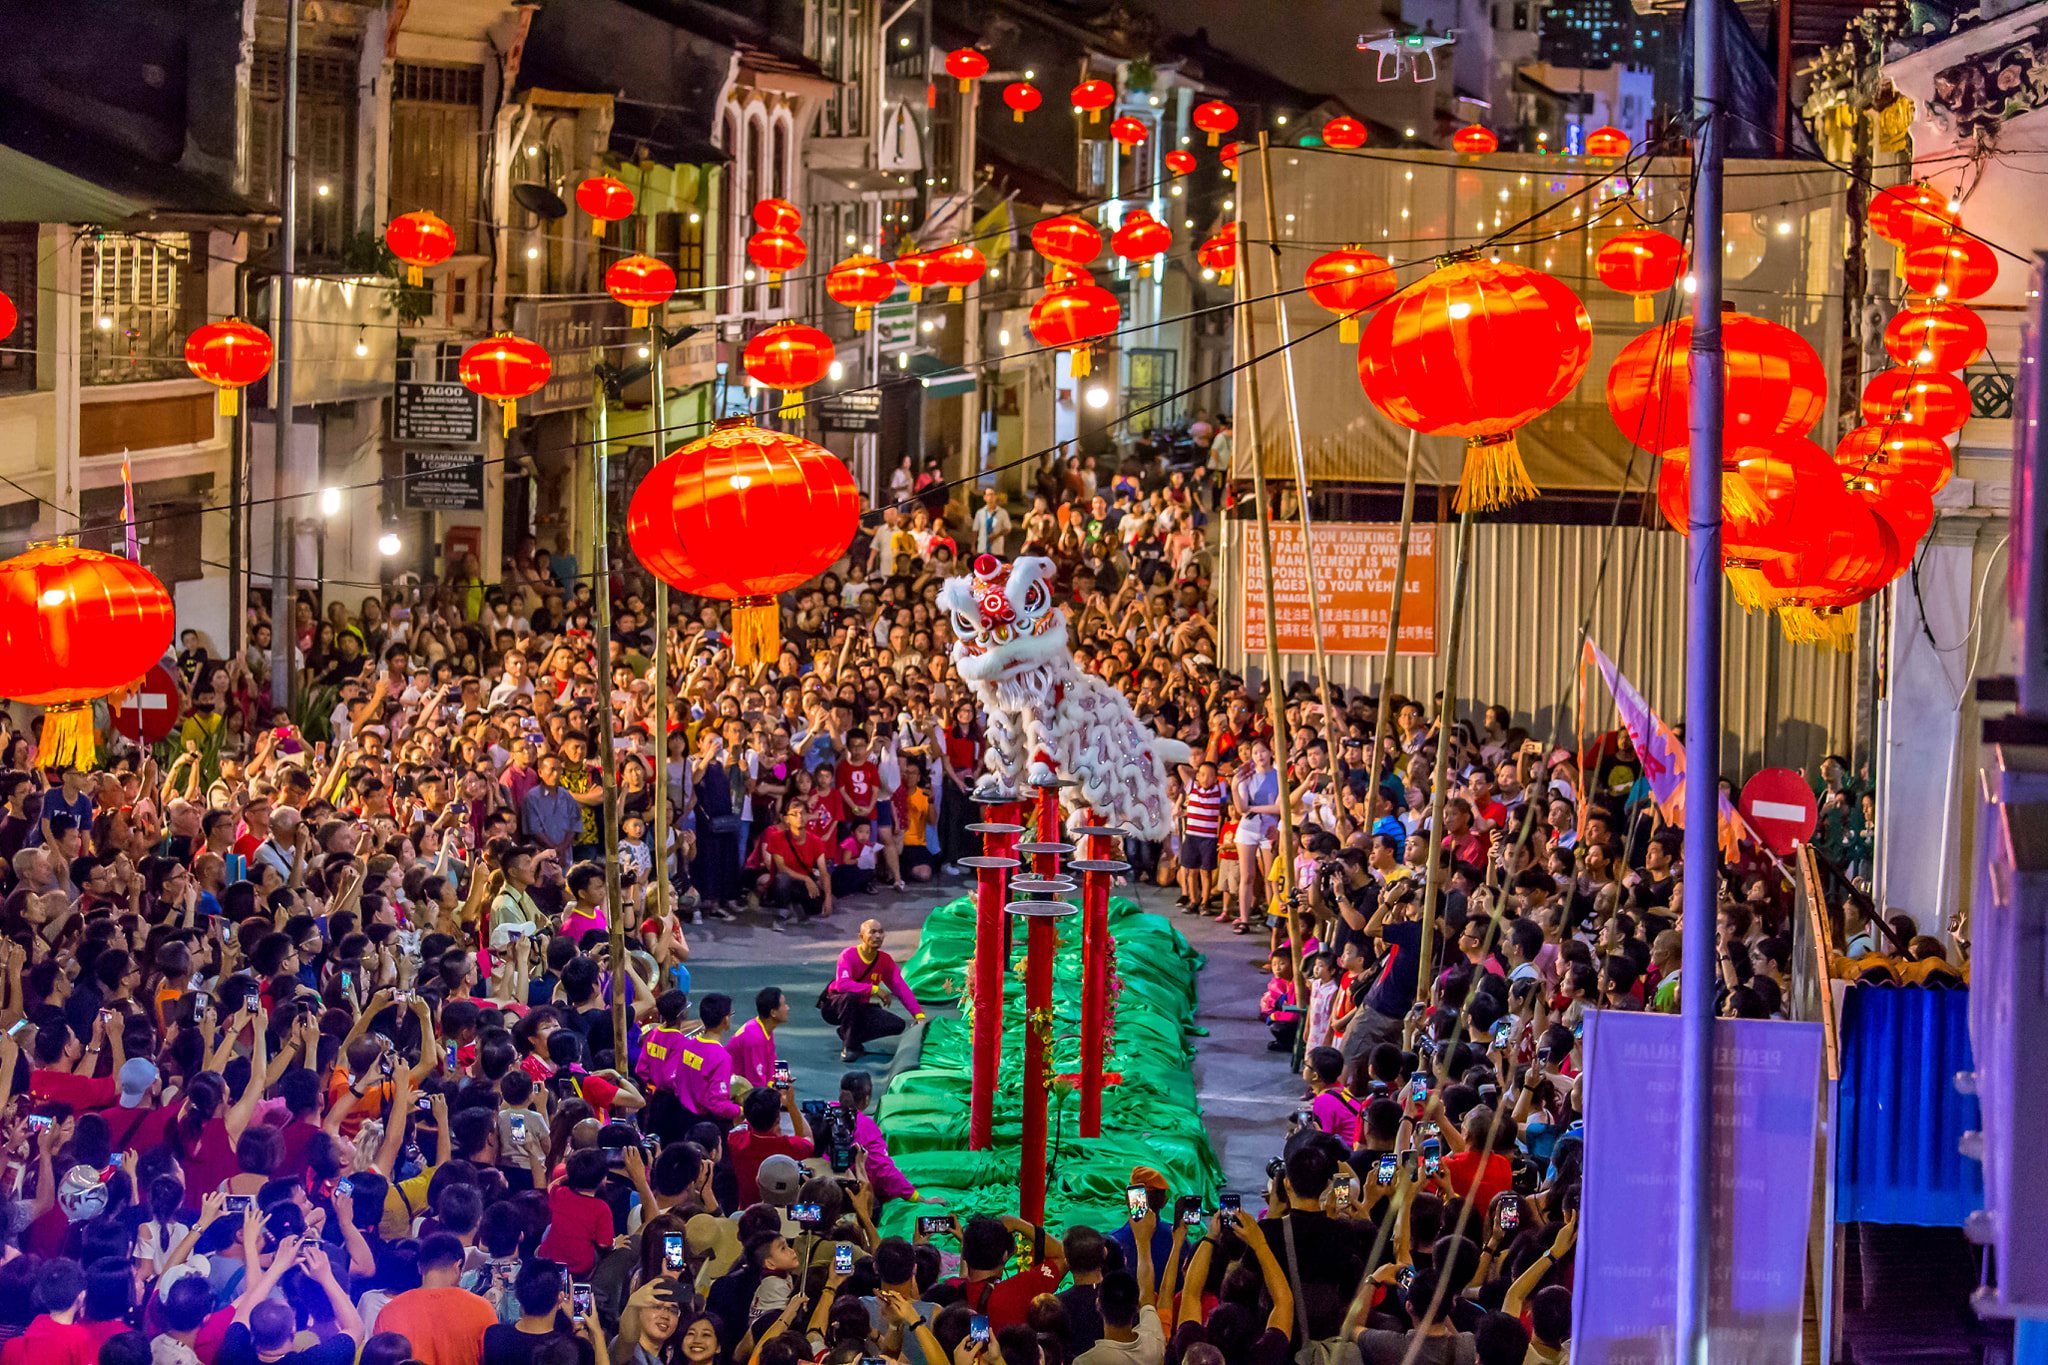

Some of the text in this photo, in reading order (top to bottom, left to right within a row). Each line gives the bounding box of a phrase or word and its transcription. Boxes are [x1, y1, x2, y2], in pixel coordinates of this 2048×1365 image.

[422, 386, 463, 397] YAGOO
[1280, 530, 1292, 541] IS
[1340, 532, 1394, 543] PARKING
[1313, 544, 1328, 554] AT
[1333, 544, 1366, 555] YOUR
[1370, 545, 1399, 555] OWN
[1367, 557, 1377, 567] IS
[1337, 568, 1352, 579] TO
[1356, 568, 1381, 579] ANY
[1248, 579, 1306, 591] DAAGES
[1330, 581, 1363, 592] YOUR
